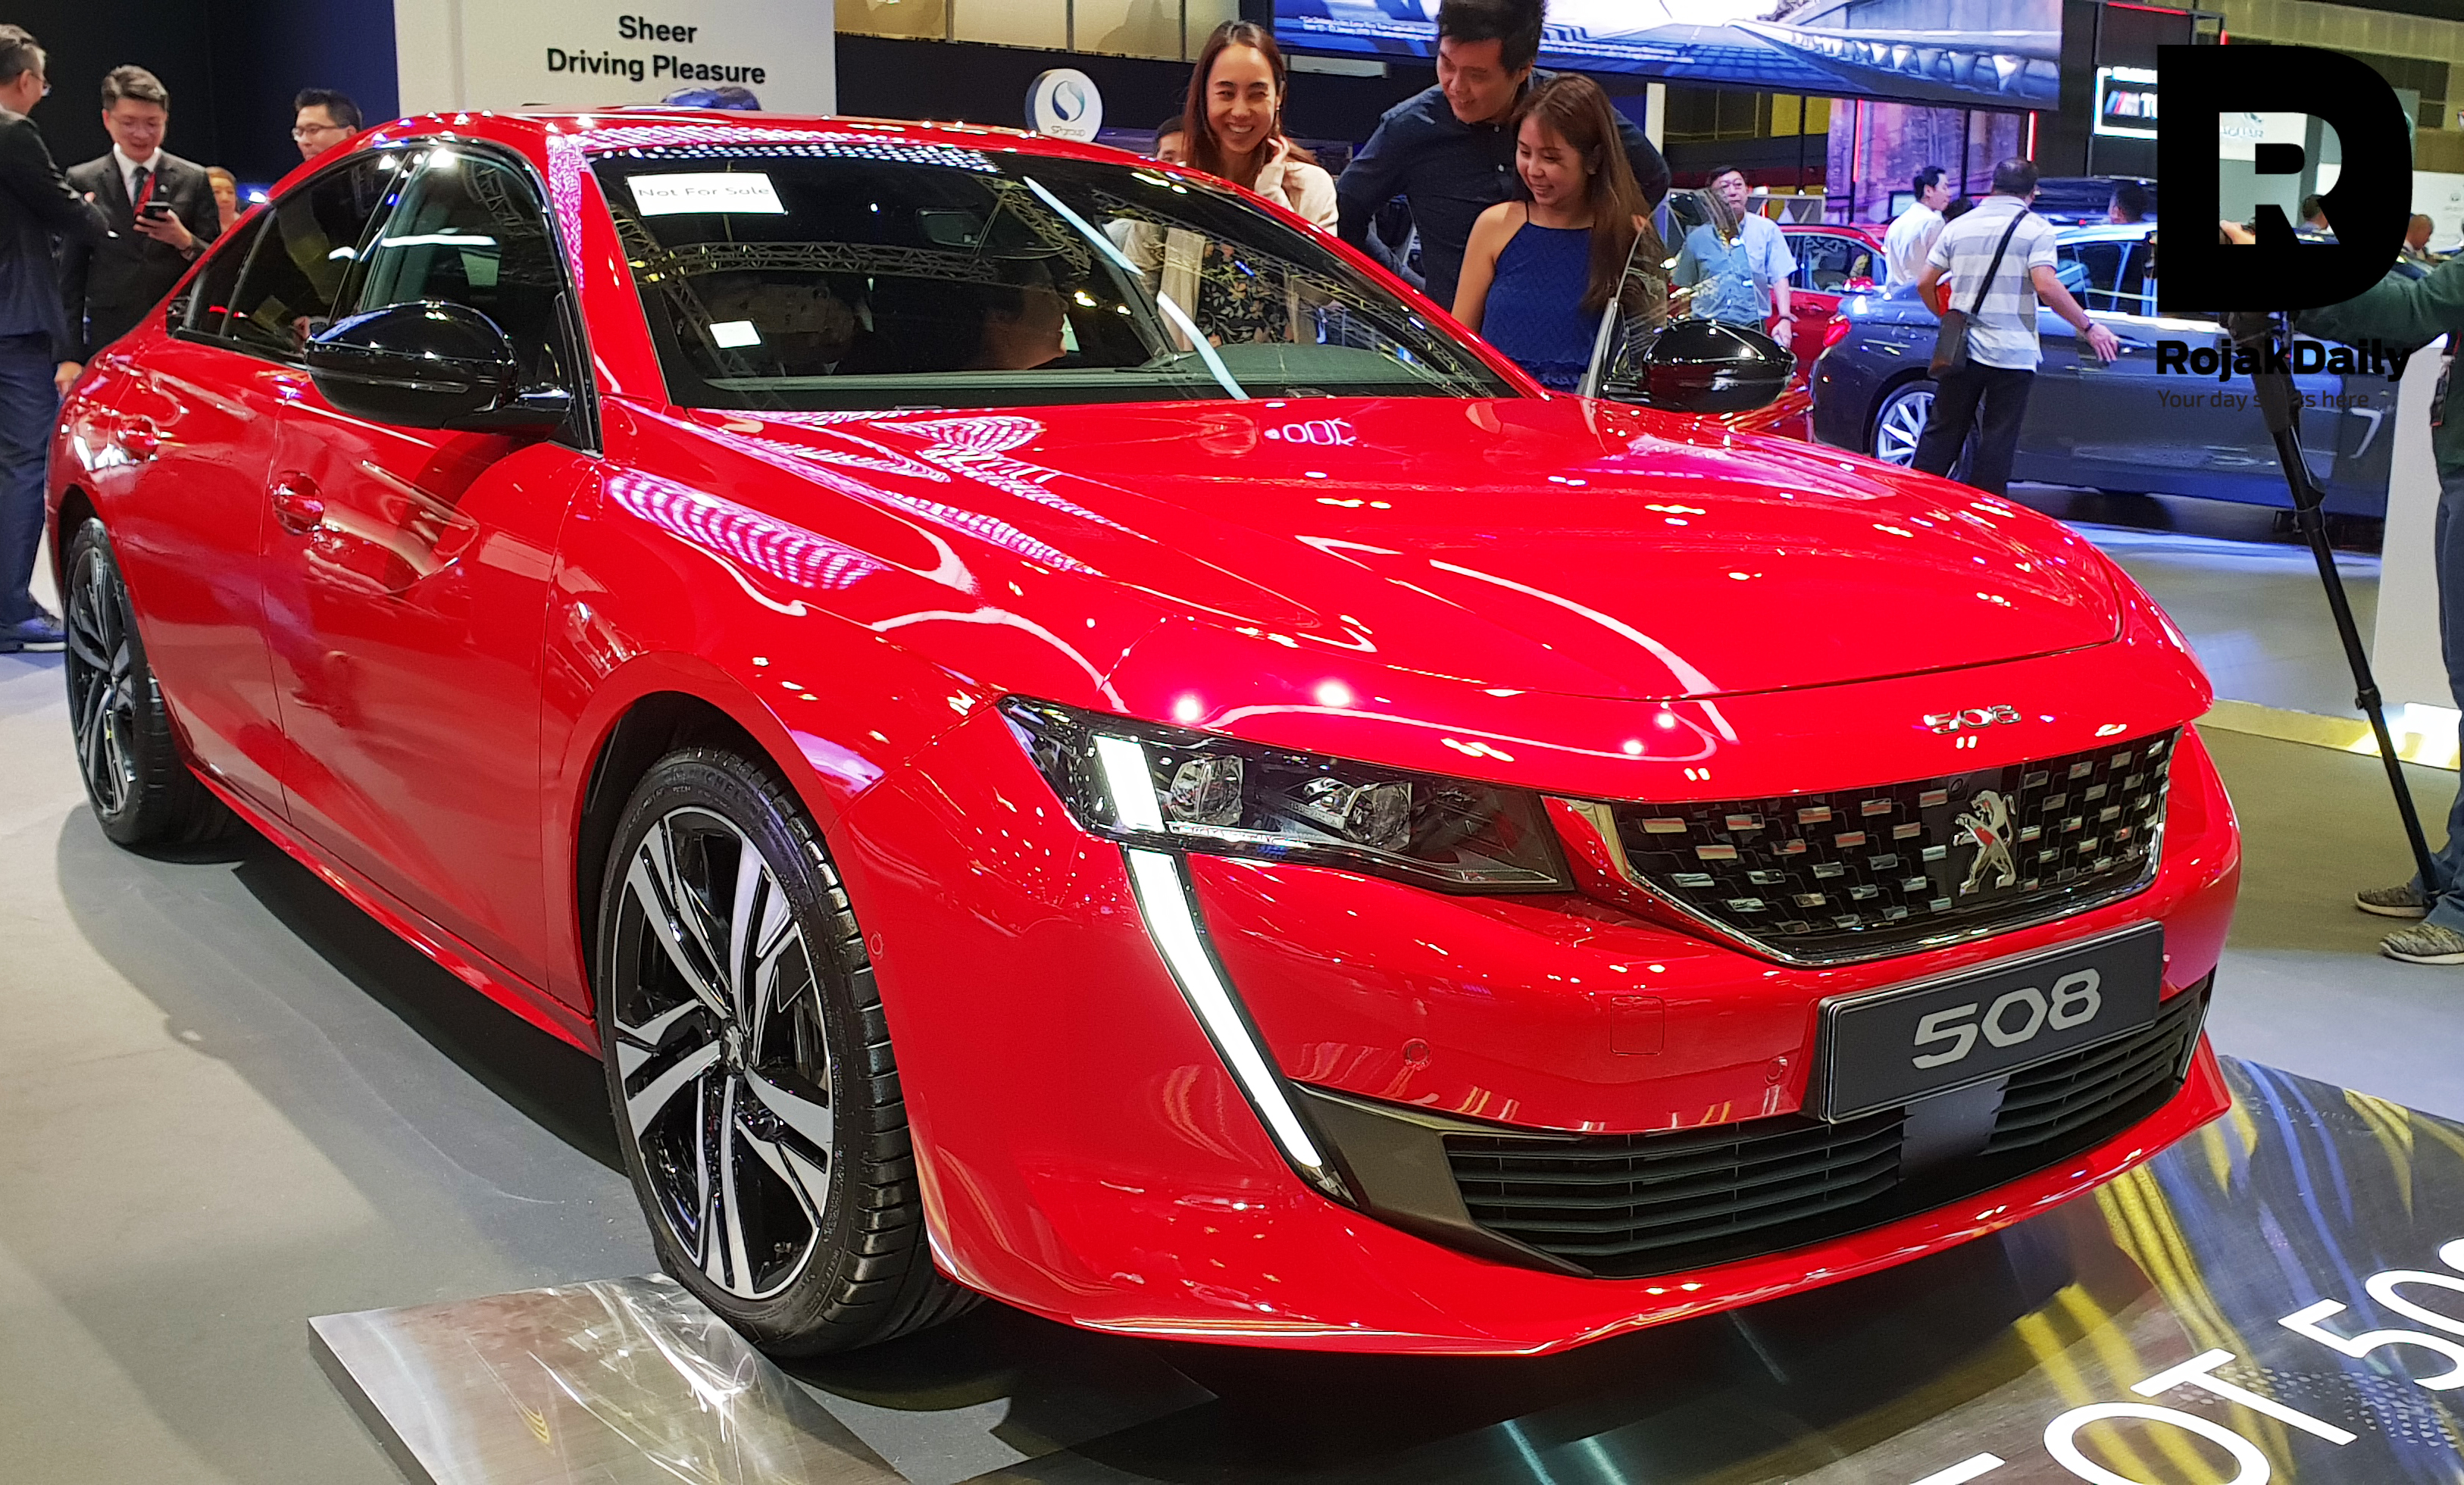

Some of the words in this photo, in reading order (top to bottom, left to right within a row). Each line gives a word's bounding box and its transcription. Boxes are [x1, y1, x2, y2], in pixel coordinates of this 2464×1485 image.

[618, 15, 698, 43] Sheer
[547, 48, 644, 82] Driving
[652, 55, 765, 84] Pleasure
[2219, 126, 2265, 138] AGUAR
[638, 189, 678, 197] Not
[685, 187, 717, 196] For
[1922, 704, 2022, 735] 508
[1912, 968, 2102, 1070] 508
[1909, 1348, 2358, 1485] OT
